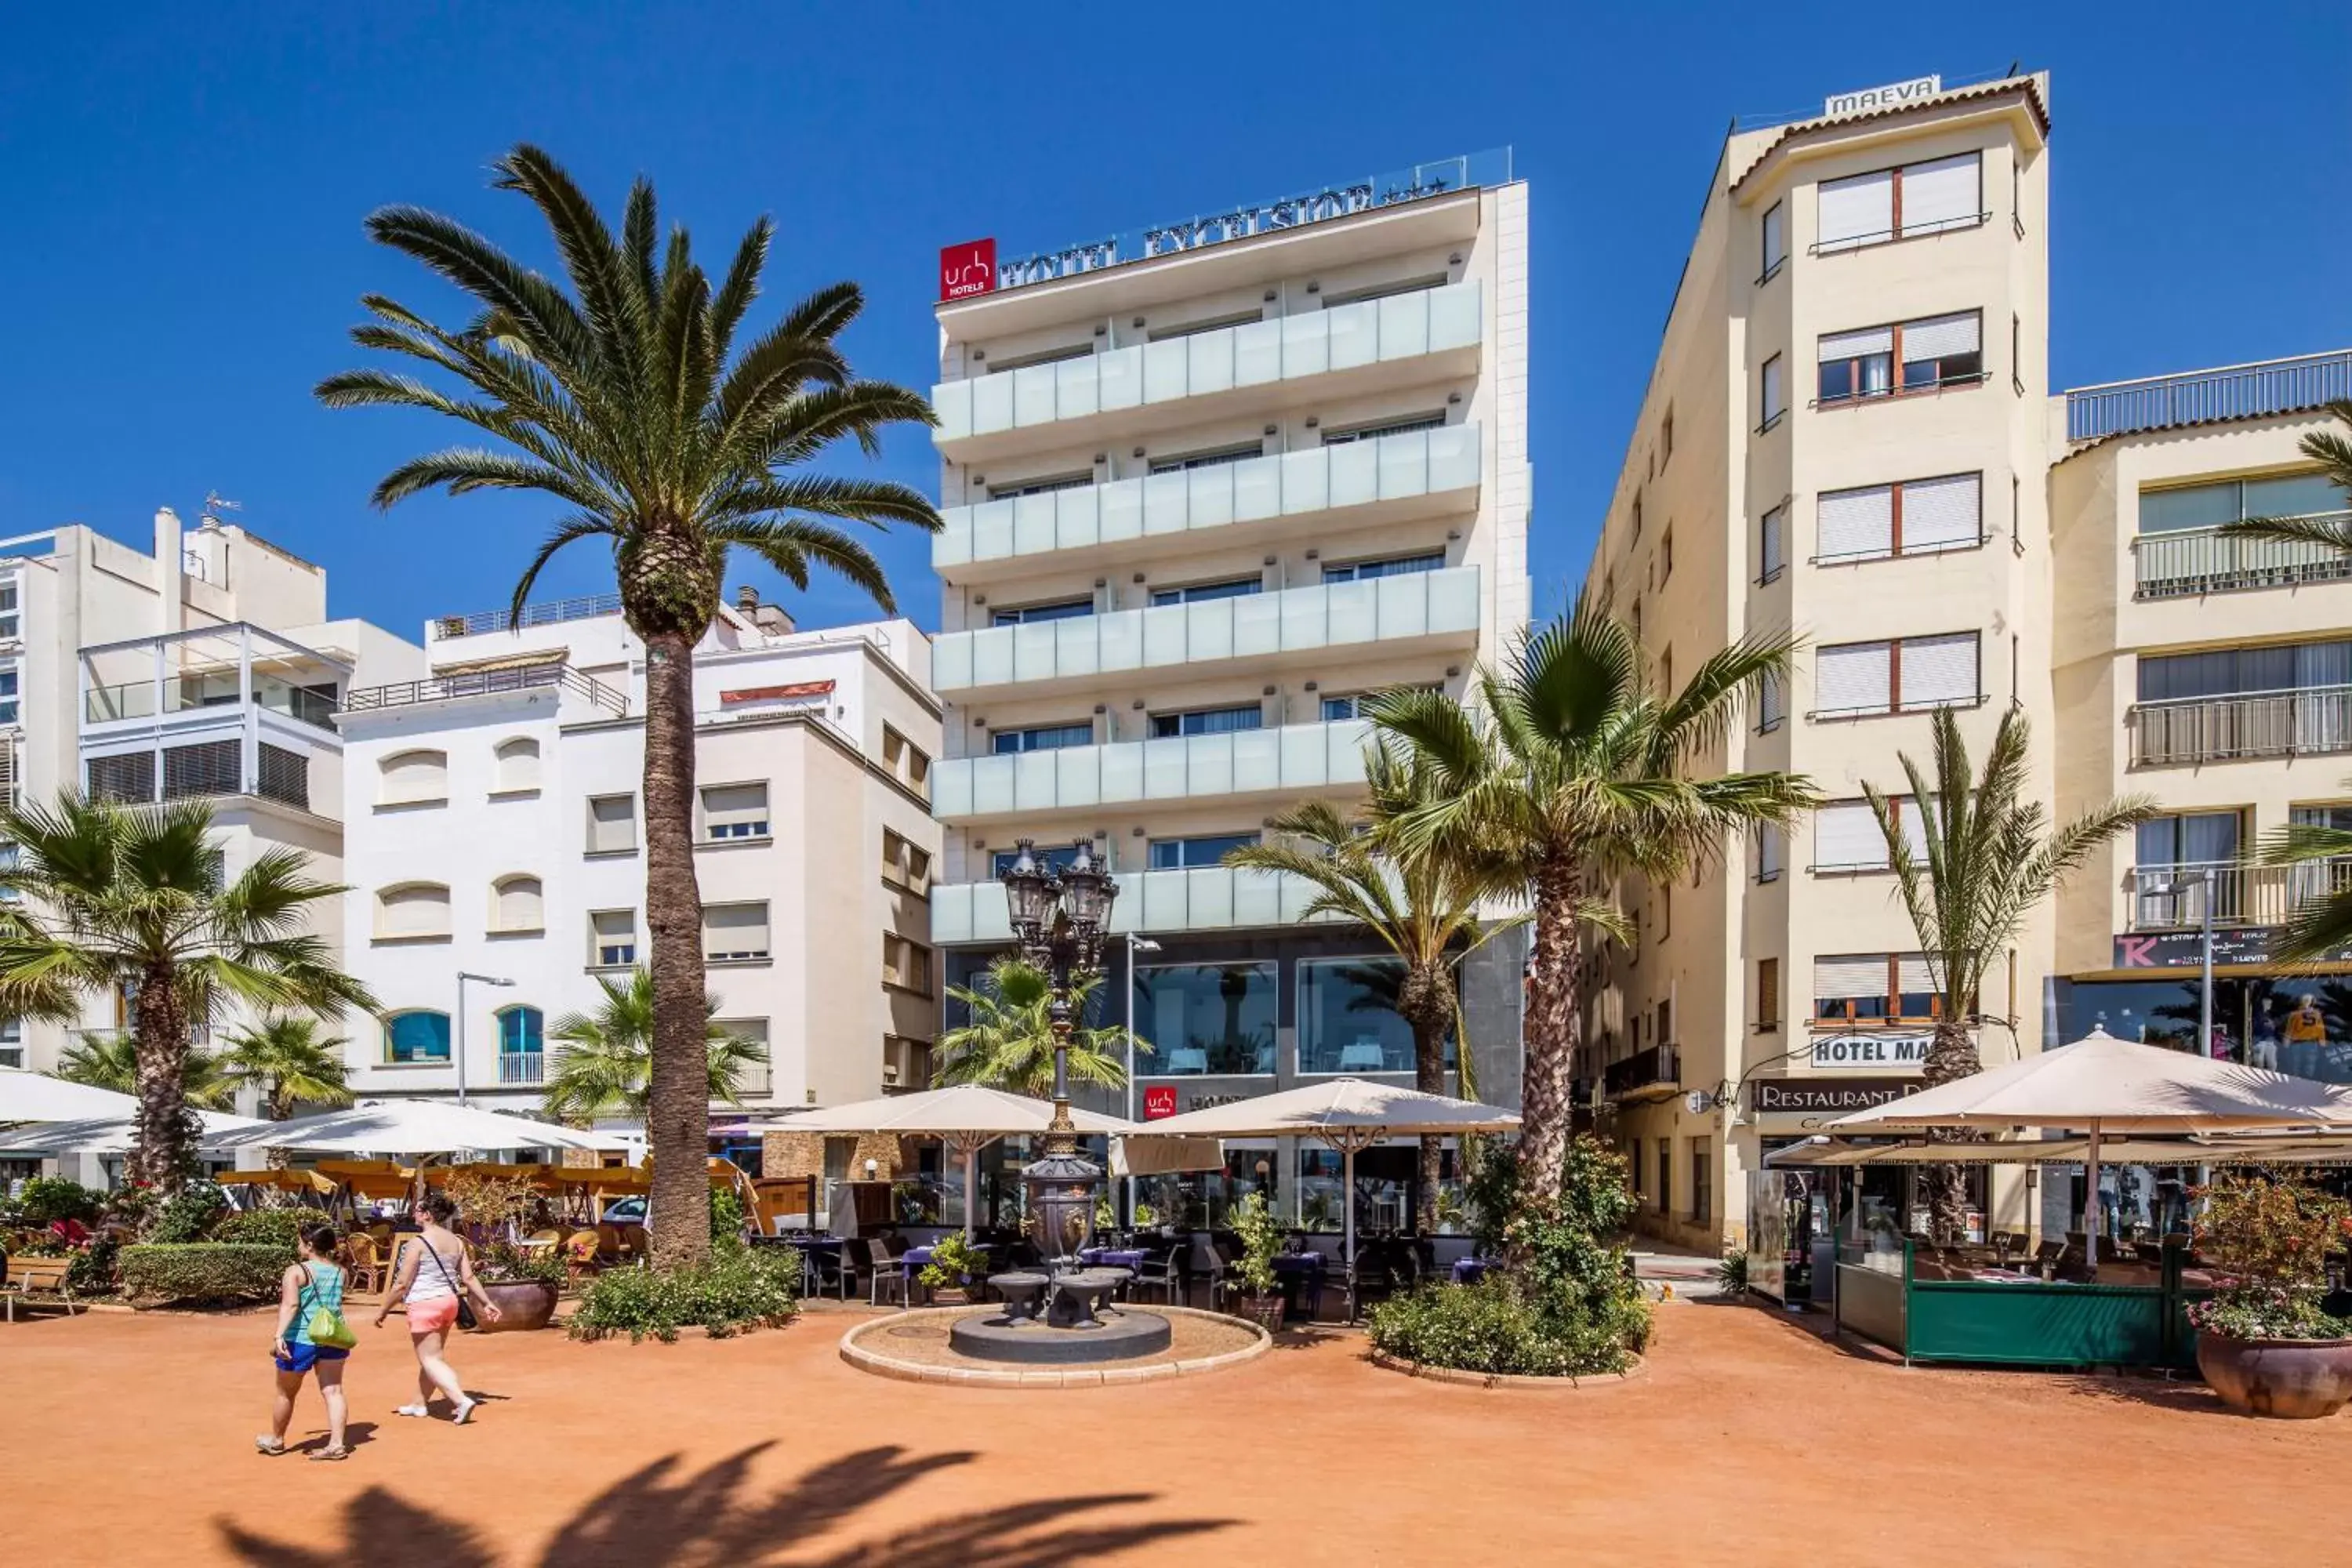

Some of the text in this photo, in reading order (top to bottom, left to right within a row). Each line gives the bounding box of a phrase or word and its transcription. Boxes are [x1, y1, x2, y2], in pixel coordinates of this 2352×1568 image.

[1833, 81, 1933, 114] MAEVA
[999, 184, 1373, 290] HOTEL EXCELSIOR
[945, 250, 989, 285] urh
[949, 281, 984, 296] HOTELS
[1816, 1042, 1885, 1061] HOTEL
[1148, 1091, 1173, 1108] urh
[1763, 1086, 1896, 1107] RESTAURANT
